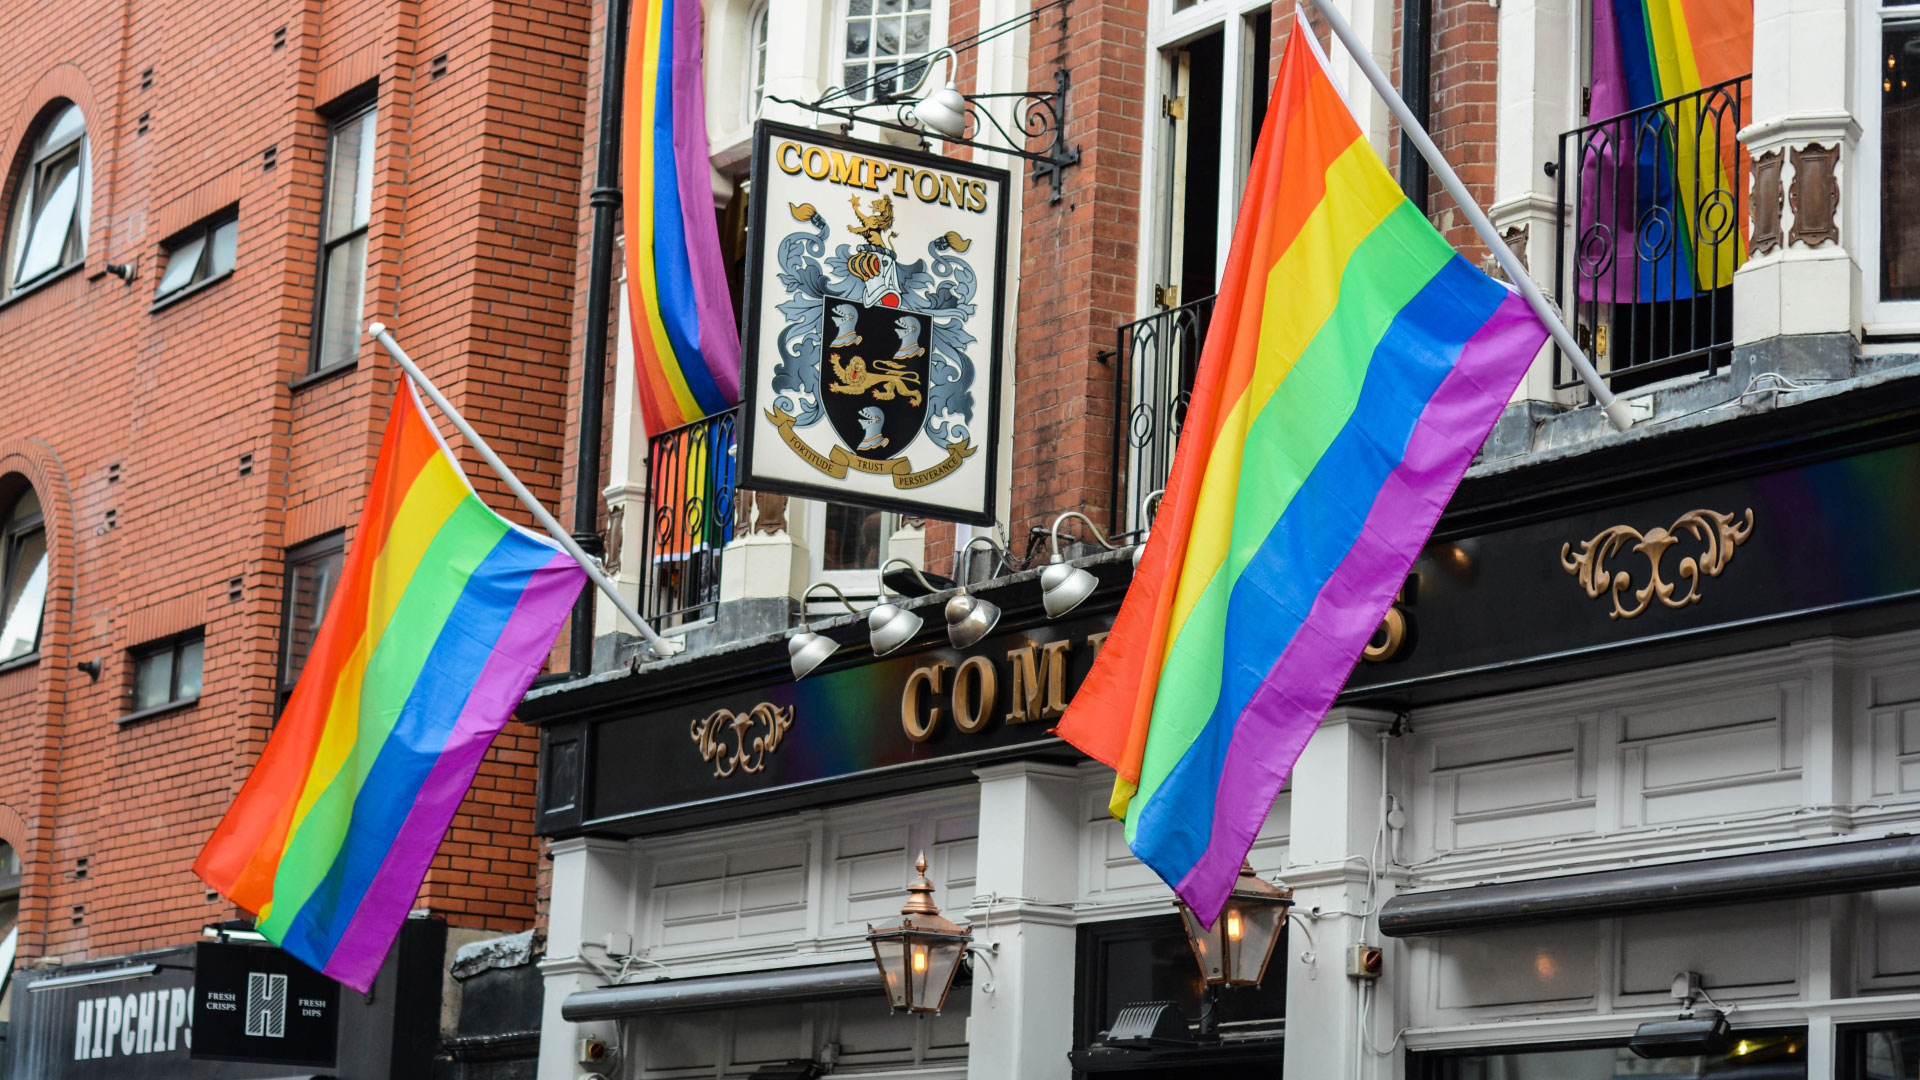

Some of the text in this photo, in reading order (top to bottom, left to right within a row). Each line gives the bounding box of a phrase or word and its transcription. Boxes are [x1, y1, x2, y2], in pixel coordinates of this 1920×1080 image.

[776, 141, 988, 213] COMPTONS
[789, 436, 834, 474] FORTITUDE
[857, 459, 885, 472] TRUST
[899, 454, 959, 486] PERSEVERANCE
[208, 992, 236, 1001] FRESH
[298, 998, 326, 1008] FRESH
[206, 1001, 237, 1011] CRISPS
[245, 972, 288, 1038] H
[302, 1008, 322, 1017] DIPS
